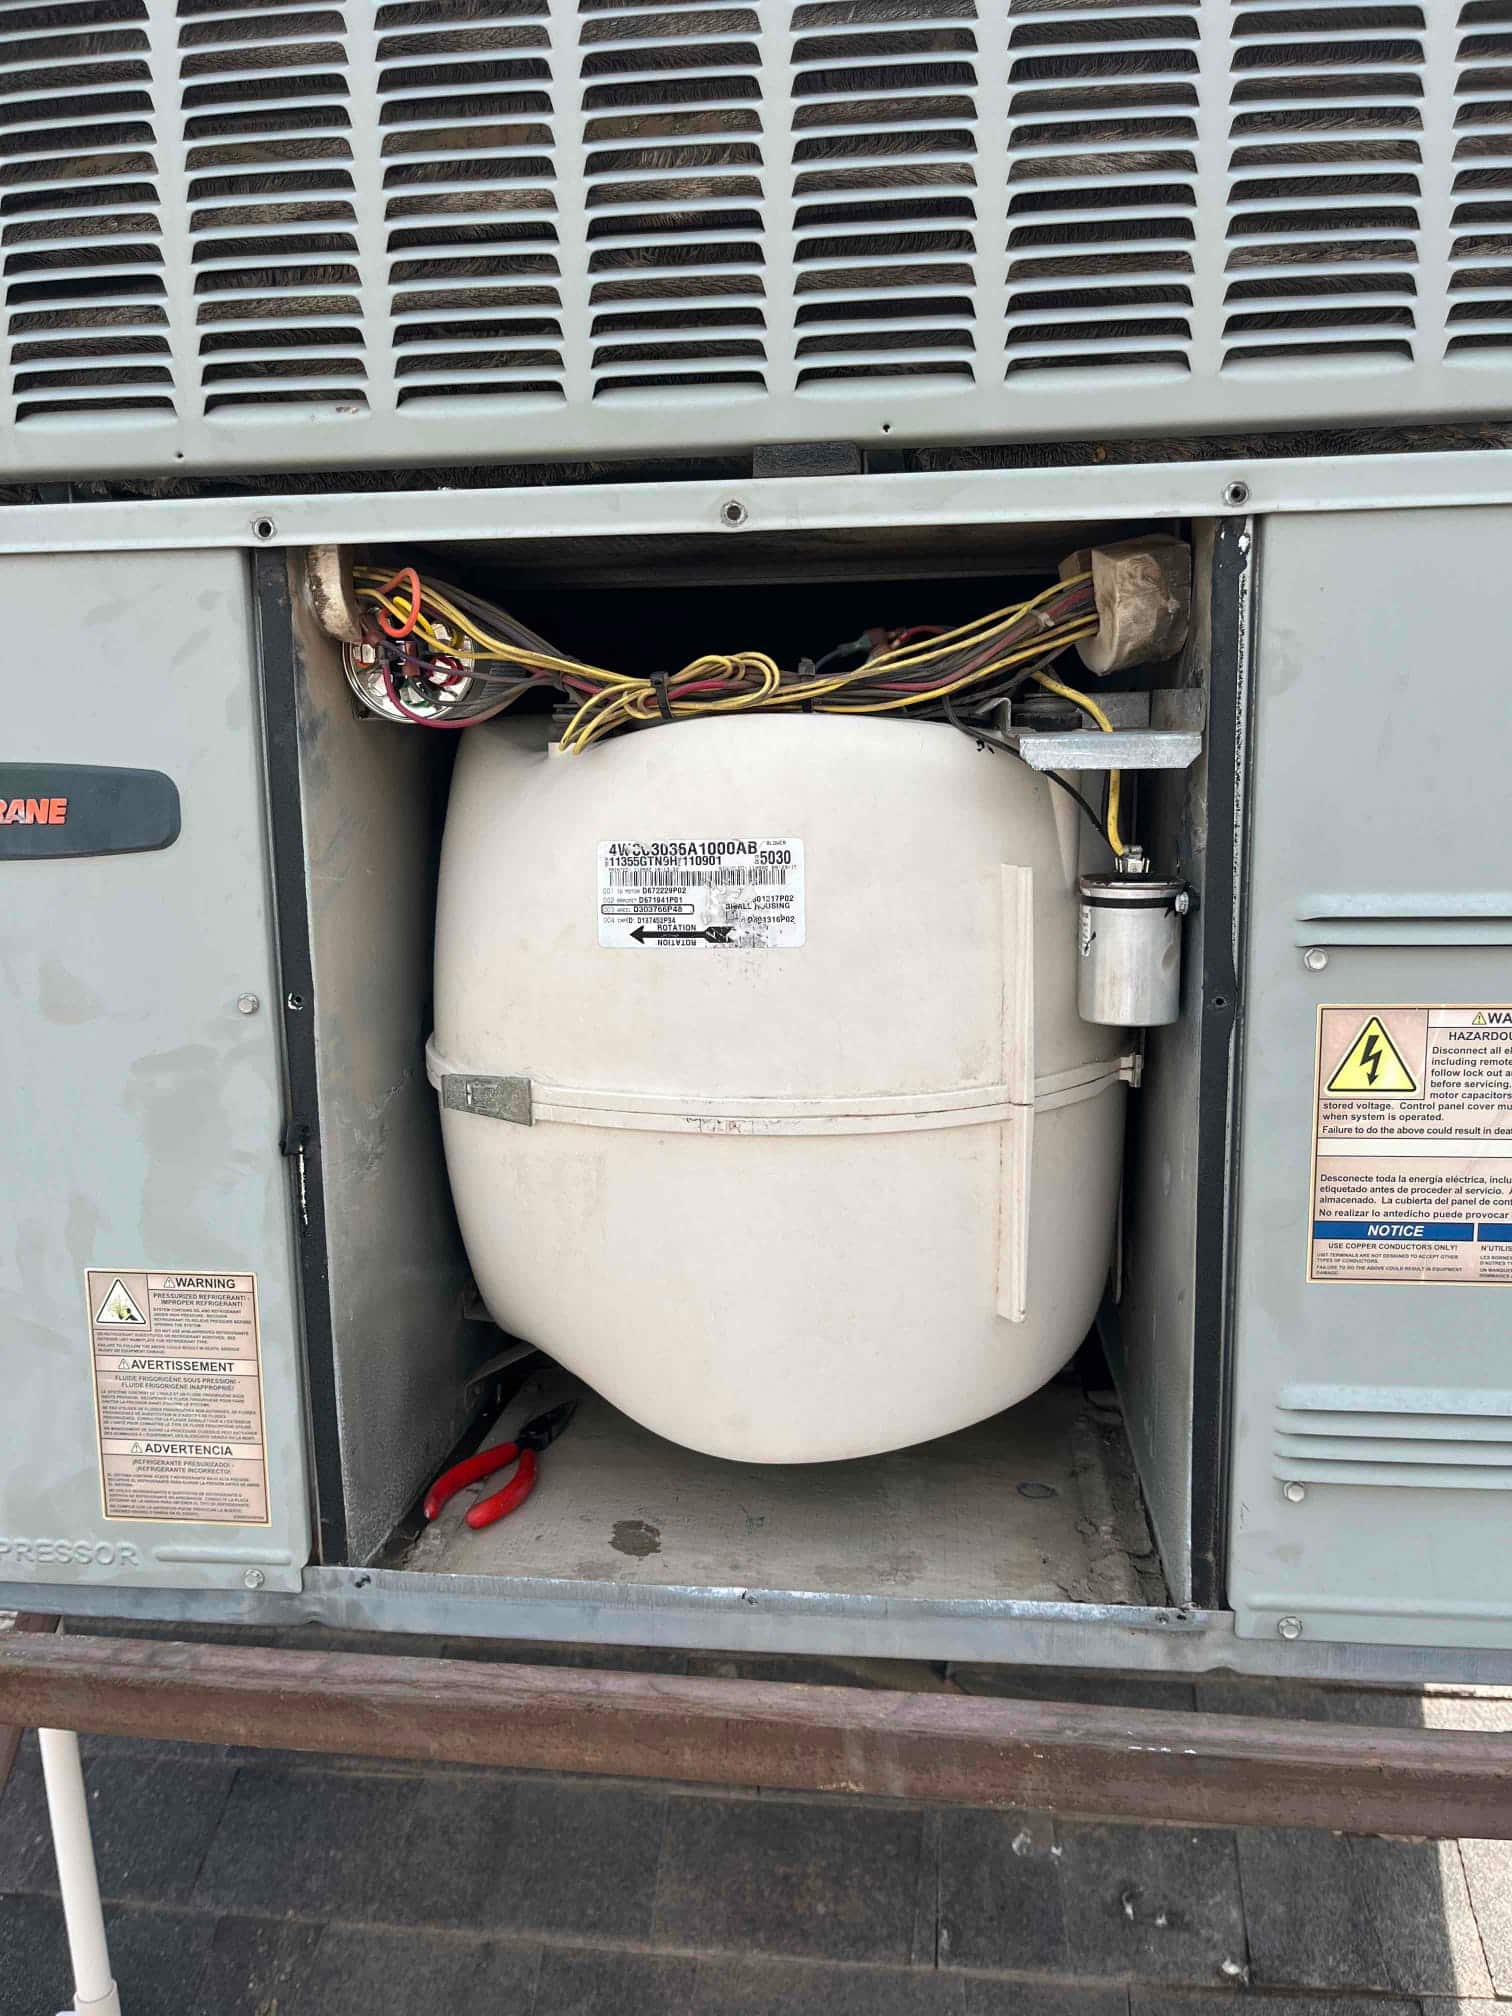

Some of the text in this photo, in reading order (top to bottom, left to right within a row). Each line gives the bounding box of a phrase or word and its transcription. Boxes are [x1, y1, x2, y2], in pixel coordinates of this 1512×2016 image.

[609, 856, 678, 867] 11355GTN9H
[684, 855, 722, 866] 110901
[760, 850, 791, 865] 5030
[1432, 1046, 1487, 1055] Disconnect
[1490, 1046, 1501, 1055] all
[1431, 1057, 1477, 1067] including
[1431, 1069, 1460, 1077] follow
[1463, 1069, 1483, 1077] lock
[1430, 1080, 1512, 1090] before servicing.
[1461, 1091, 1512, 1101] capacitors
[1356, 1102, 1394, 1111] voltage.
[1400, 1102, 1435, 1110] Control
[1438, 1102, 1464, 1111] panel
[1350, 1113, 1385, 1122] system
[1398, 1113, 1445, 1122] operated.
[1322, 1125, 1353, 1134] Failure
[1355, 1126, 1364, 1134] to
[1366, 1126, 1378, 1134] do
[1380, 1126, 1394, 1134] the
[1397, 1126, 1424, 1134] above
[1427, 1126, 1453, 1134] could
[1455, 1126, 1480, 1135] result
[1483, 1126, 1491, 1135] in
[1320, 1174, 1374, 1182] Desconecte
[1409, 1176, 1443, 1184] energía
[1445, 1175, 1487, 1184] eléctrica,
[1320, 1185, 1367, 1194] etiquetado
[1411, 1186, 1452, 1195] proceder
[1465, 1187, 1504, 1195] servicio.
[1320, 1196, 1377, 1204] almacenado.
[1381, 1196, 1393, 1204] La
[1395, 1197, 1432, 1205] cubierta
[1434, 1197, 1449, 1205] del
[1451, 1198, 1476, 1206] panel
[1319, 1208, 1509, 1220] No realizar lo antedicho puede provocar
[1367, 1224, 1425, 1237] NOTICE
[175, 1277, 236, 1289] WARNING
[131, 1359, 235, 1373] AVERTISSEMENT
[145, 1443, 233, 1456] ADVERTENCIA
[0, 1537, 139, 1566] PRESSOR
